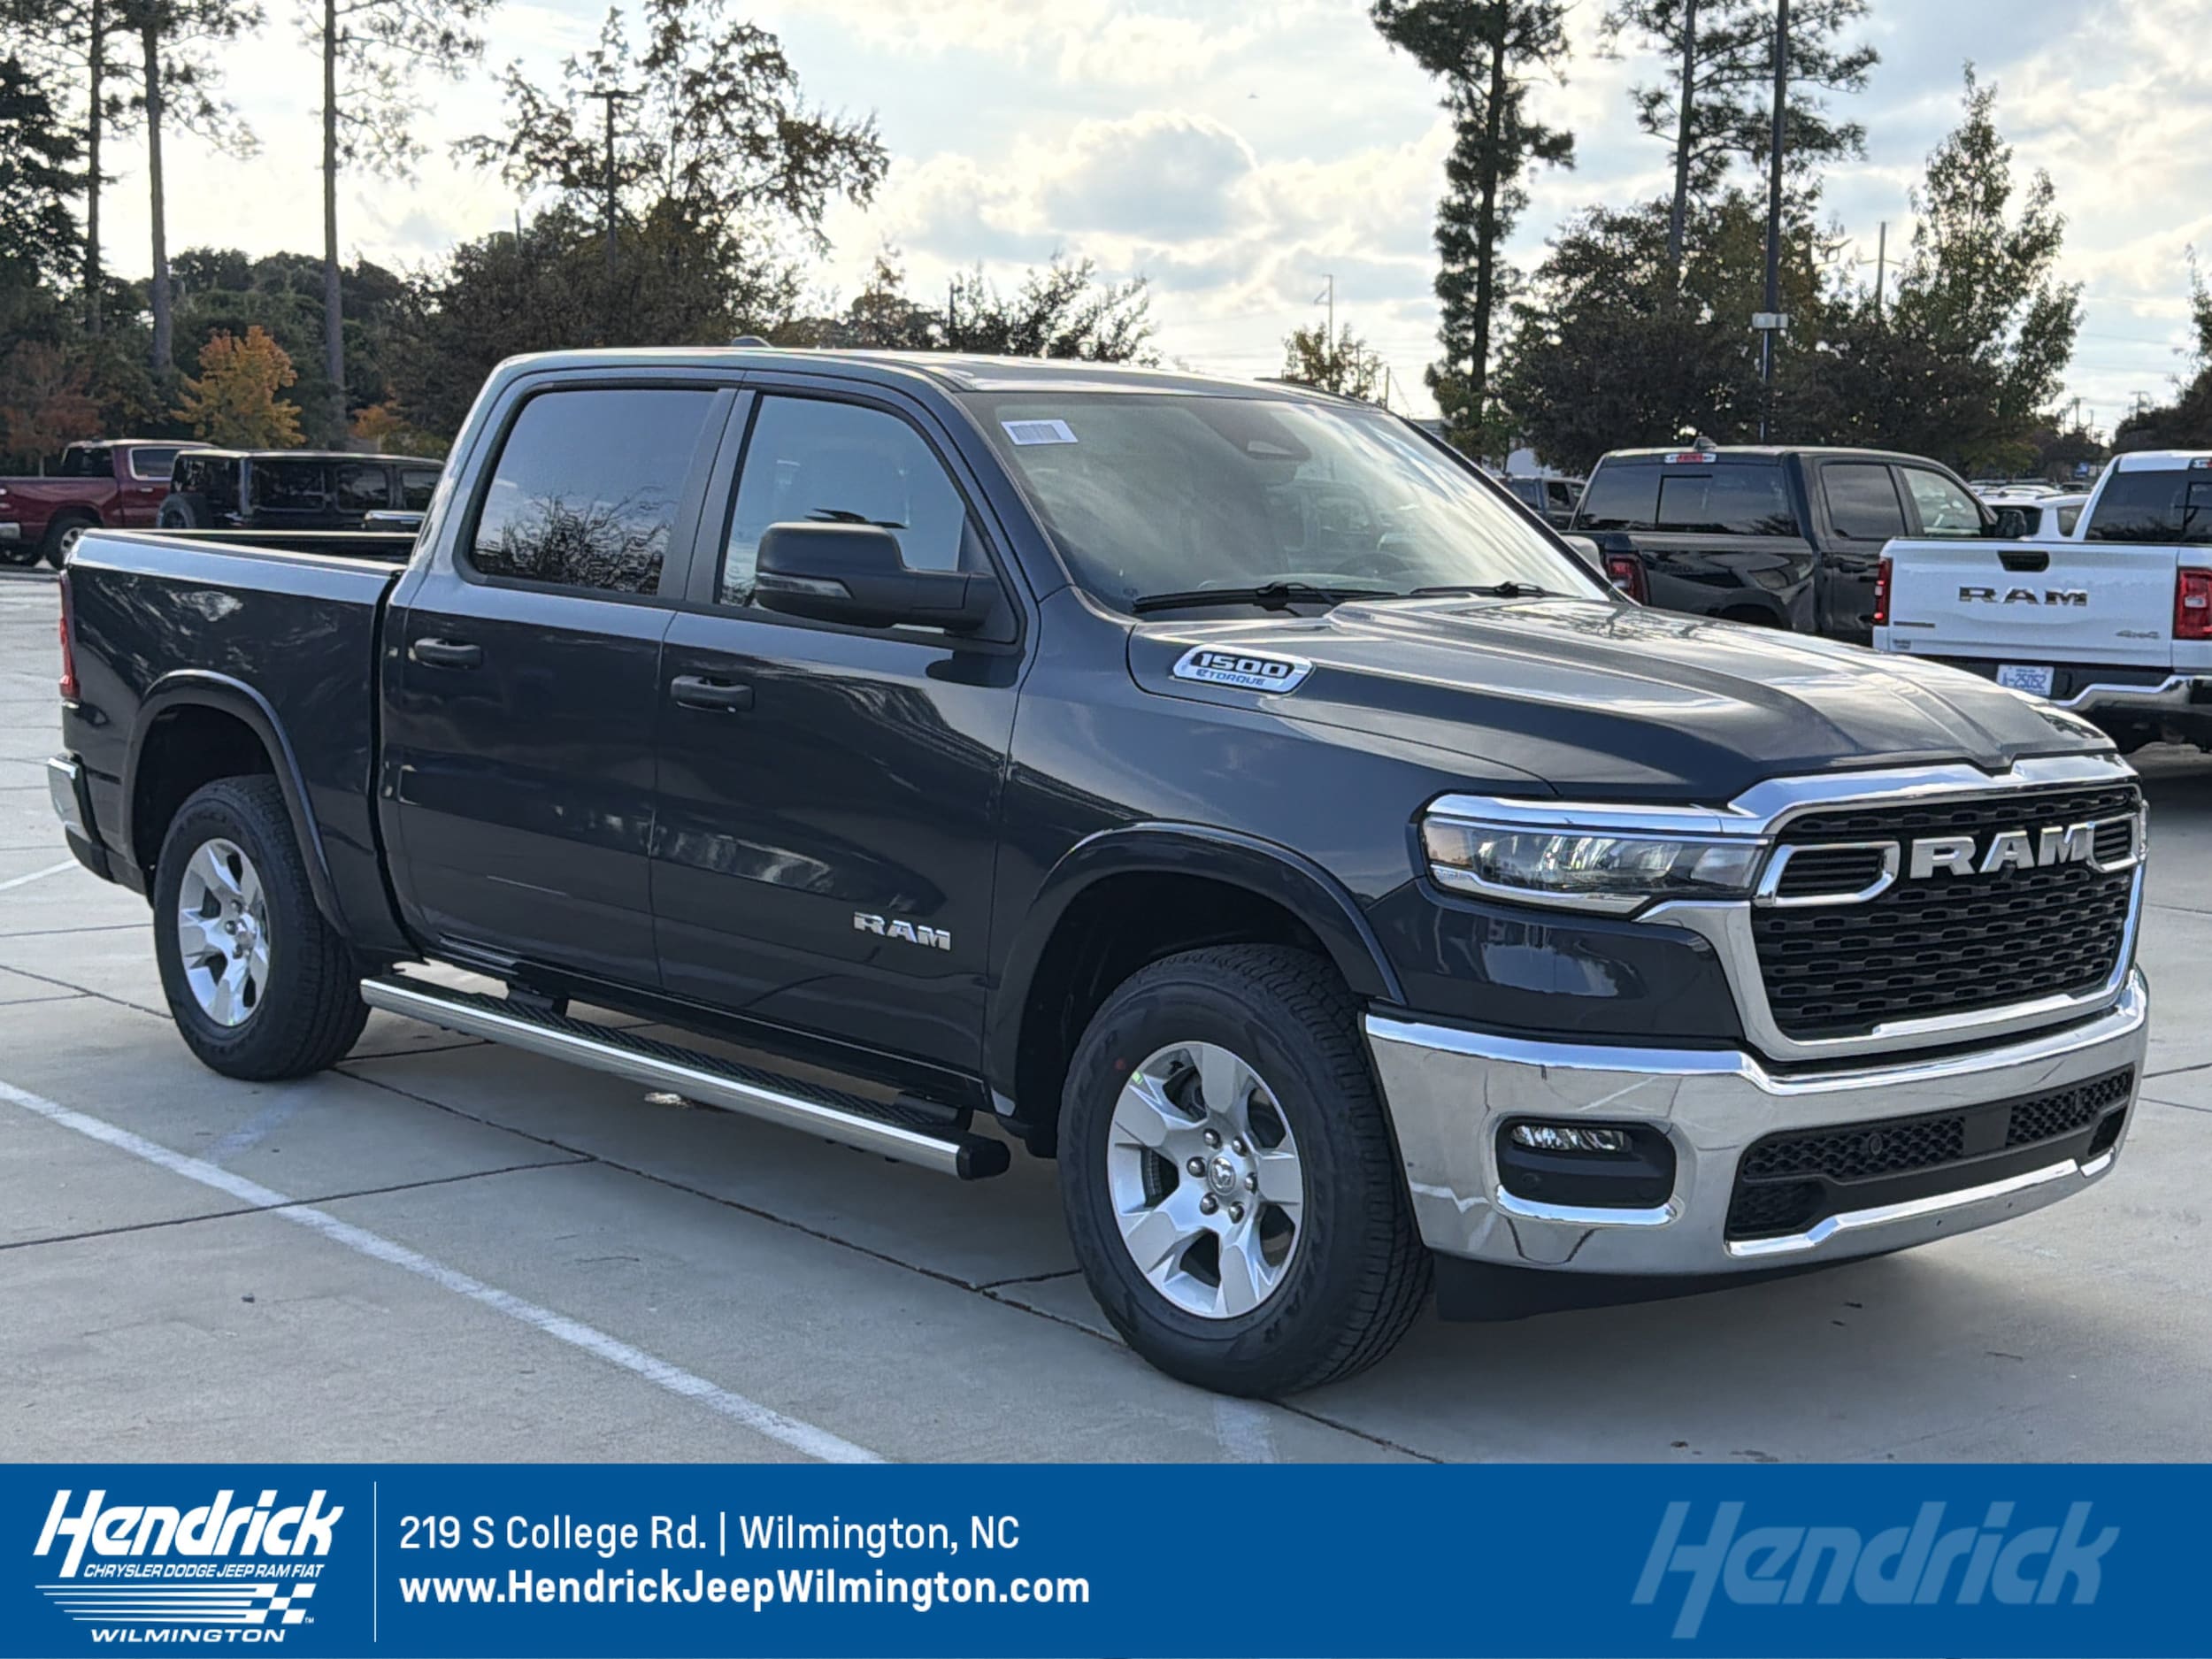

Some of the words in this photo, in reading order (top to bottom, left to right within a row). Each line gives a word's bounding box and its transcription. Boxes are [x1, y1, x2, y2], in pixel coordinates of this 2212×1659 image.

[1958, 586, 2089, 607] RAM
[1200, 653, 1289, 678] 1500
[1909, 824, 2096, 879] RAM
[853, 911, 951, 951] RAM
